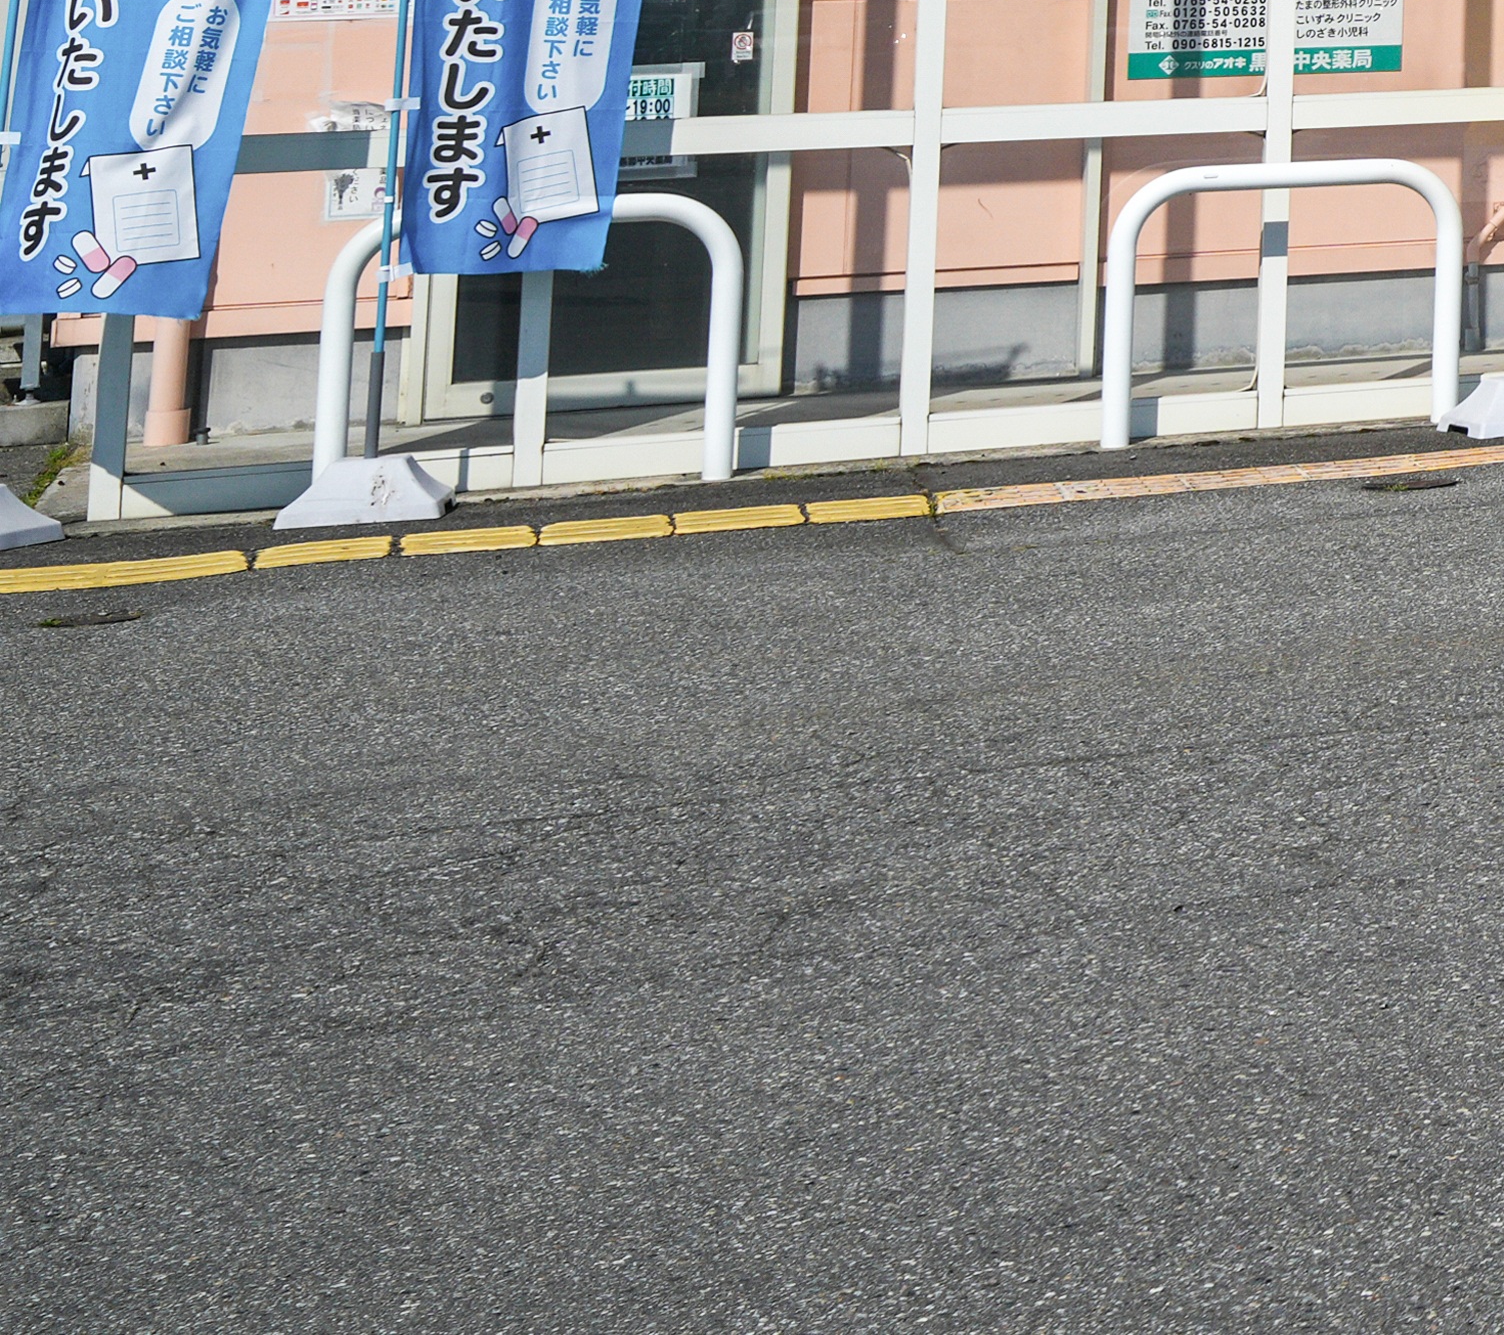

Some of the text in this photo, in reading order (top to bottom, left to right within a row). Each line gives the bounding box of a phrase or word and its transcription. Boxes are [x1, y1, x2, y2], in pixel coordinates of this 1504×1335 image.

[1173, 6, 1266, 17] 0120-505632
[1145, 17, 1266, 30] Fax. 0765-54-0208
[187, 5, 227, 95] お気軽に
[1145, 37, 1265, 50] Tel. 090-6815-1215
[1184, 57, 1246, 69] クスリのアオキ
[146, 3, 203, 139] ご相談下さい
